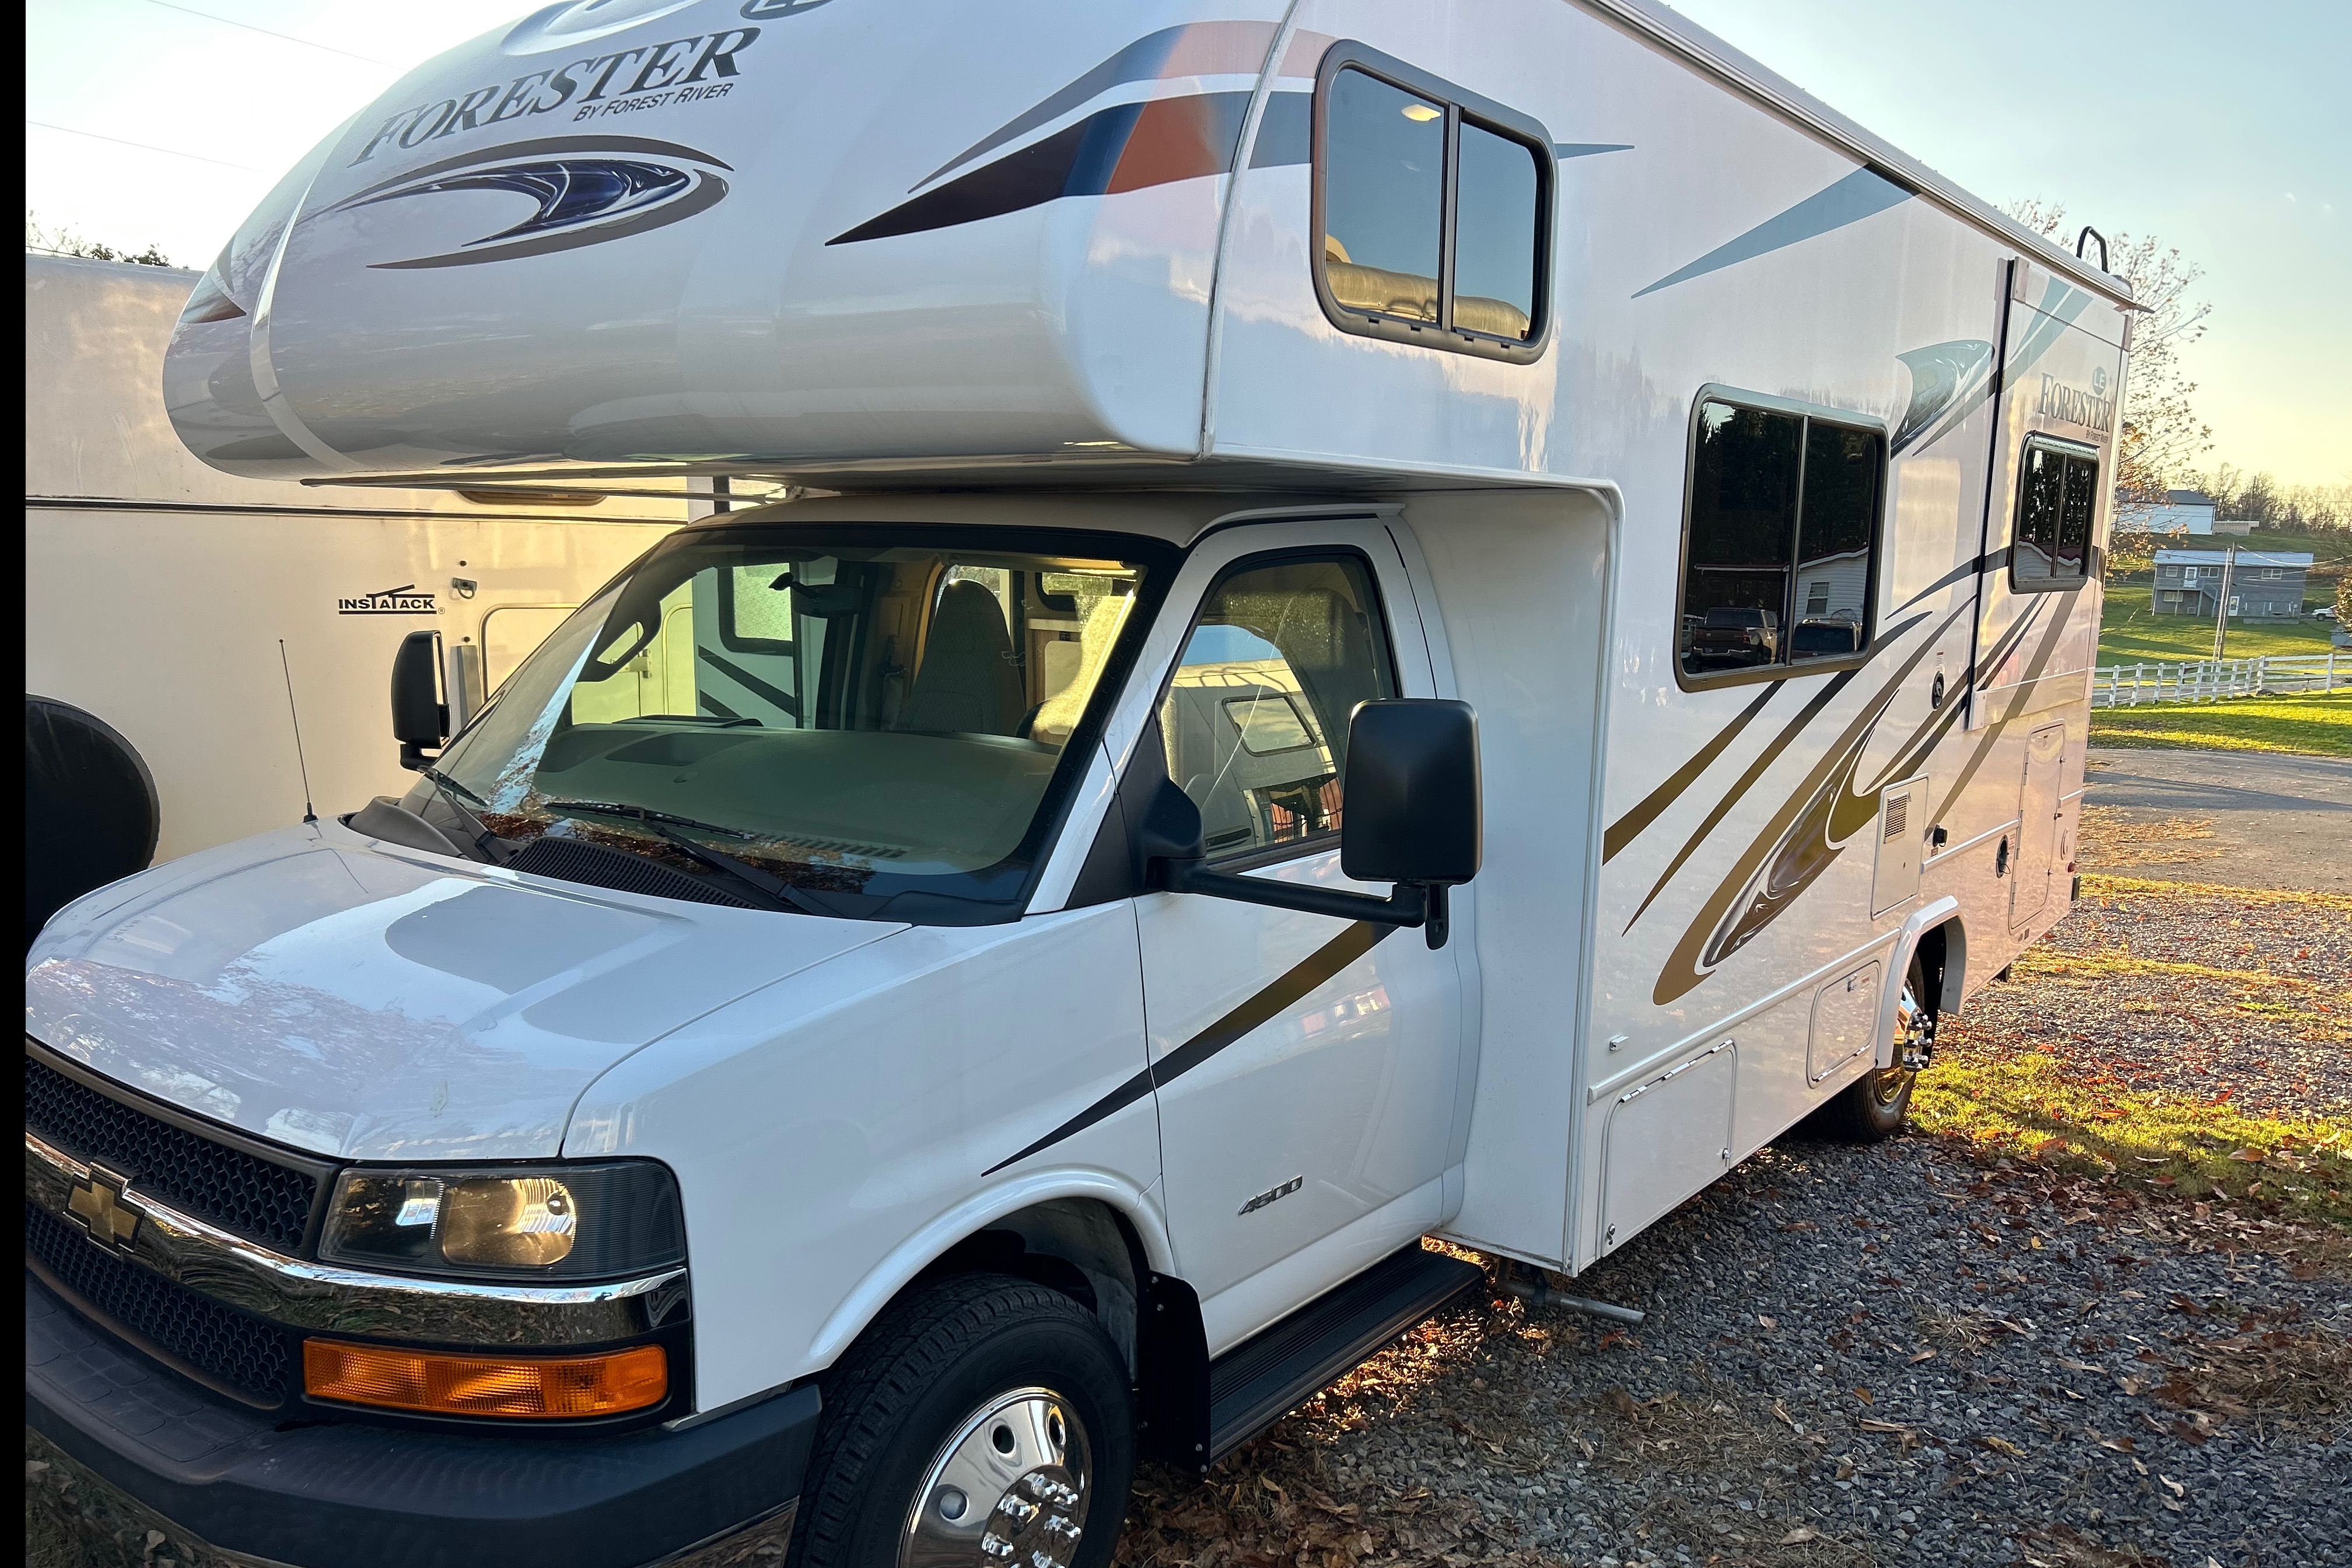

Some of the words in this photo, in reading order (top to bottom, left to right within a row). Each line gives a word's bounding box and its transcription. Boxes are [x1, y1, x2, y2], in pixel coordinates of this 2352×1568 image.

[346, 27, 761, 168] FORESTER
[573, 105, 602, 122] BY
[600, 92, 676, 117] FOREST
[673, 83, 734, 104] RIVER
[2094, 370, 2105, 390] LE
[2038, 372, 2110, 432] FORESTER
[338, 584, 436, 610] INSTATACK
[1237, 1174, 1303, 1216] 4500
